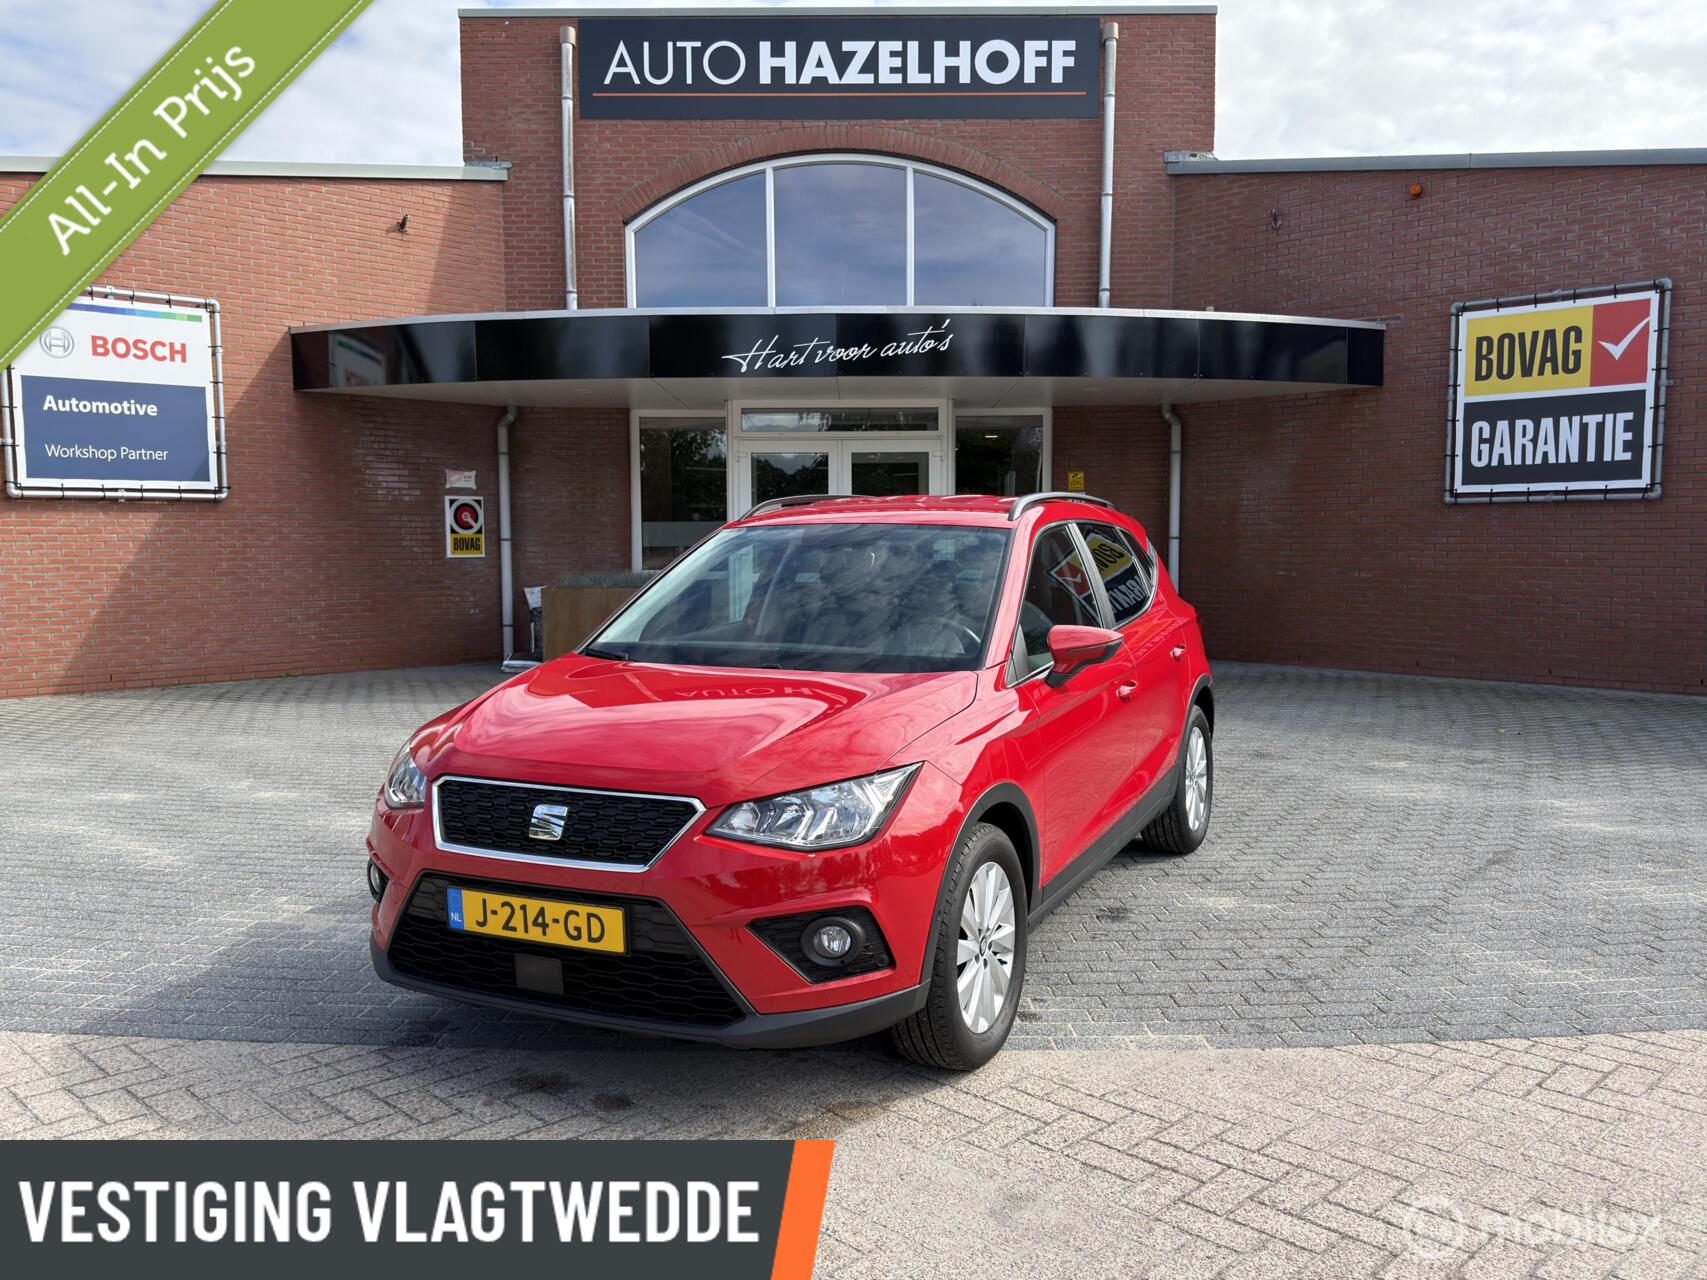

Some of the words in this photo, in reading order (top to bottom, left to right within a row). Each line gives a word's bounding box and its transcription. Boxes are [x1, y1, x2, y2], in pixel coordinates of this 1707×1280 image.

[604, 39, 746, 85] AUTO
[759, 39, 1076, 85] HAZELHOFF
[90, 335, 187, 363] BOSCH
[721, 334, 831, 373] Hart
[815, 343, 877, 364] voor
[880, 318, 953, 357] auto's
[1475, 325, 1583, 382] BOVAG
[43, 394, 158, 416] Automotive
[45, 444, 117, 462] Workshop
[120, 446, 168, 461] Partner
[1470, 411, 1634, 468] GARANTIE
[453, 537, 480, 551] BOVAG
[450, 912, 462, 922] NL
[475, 898, 605, 943] J-214-GD
